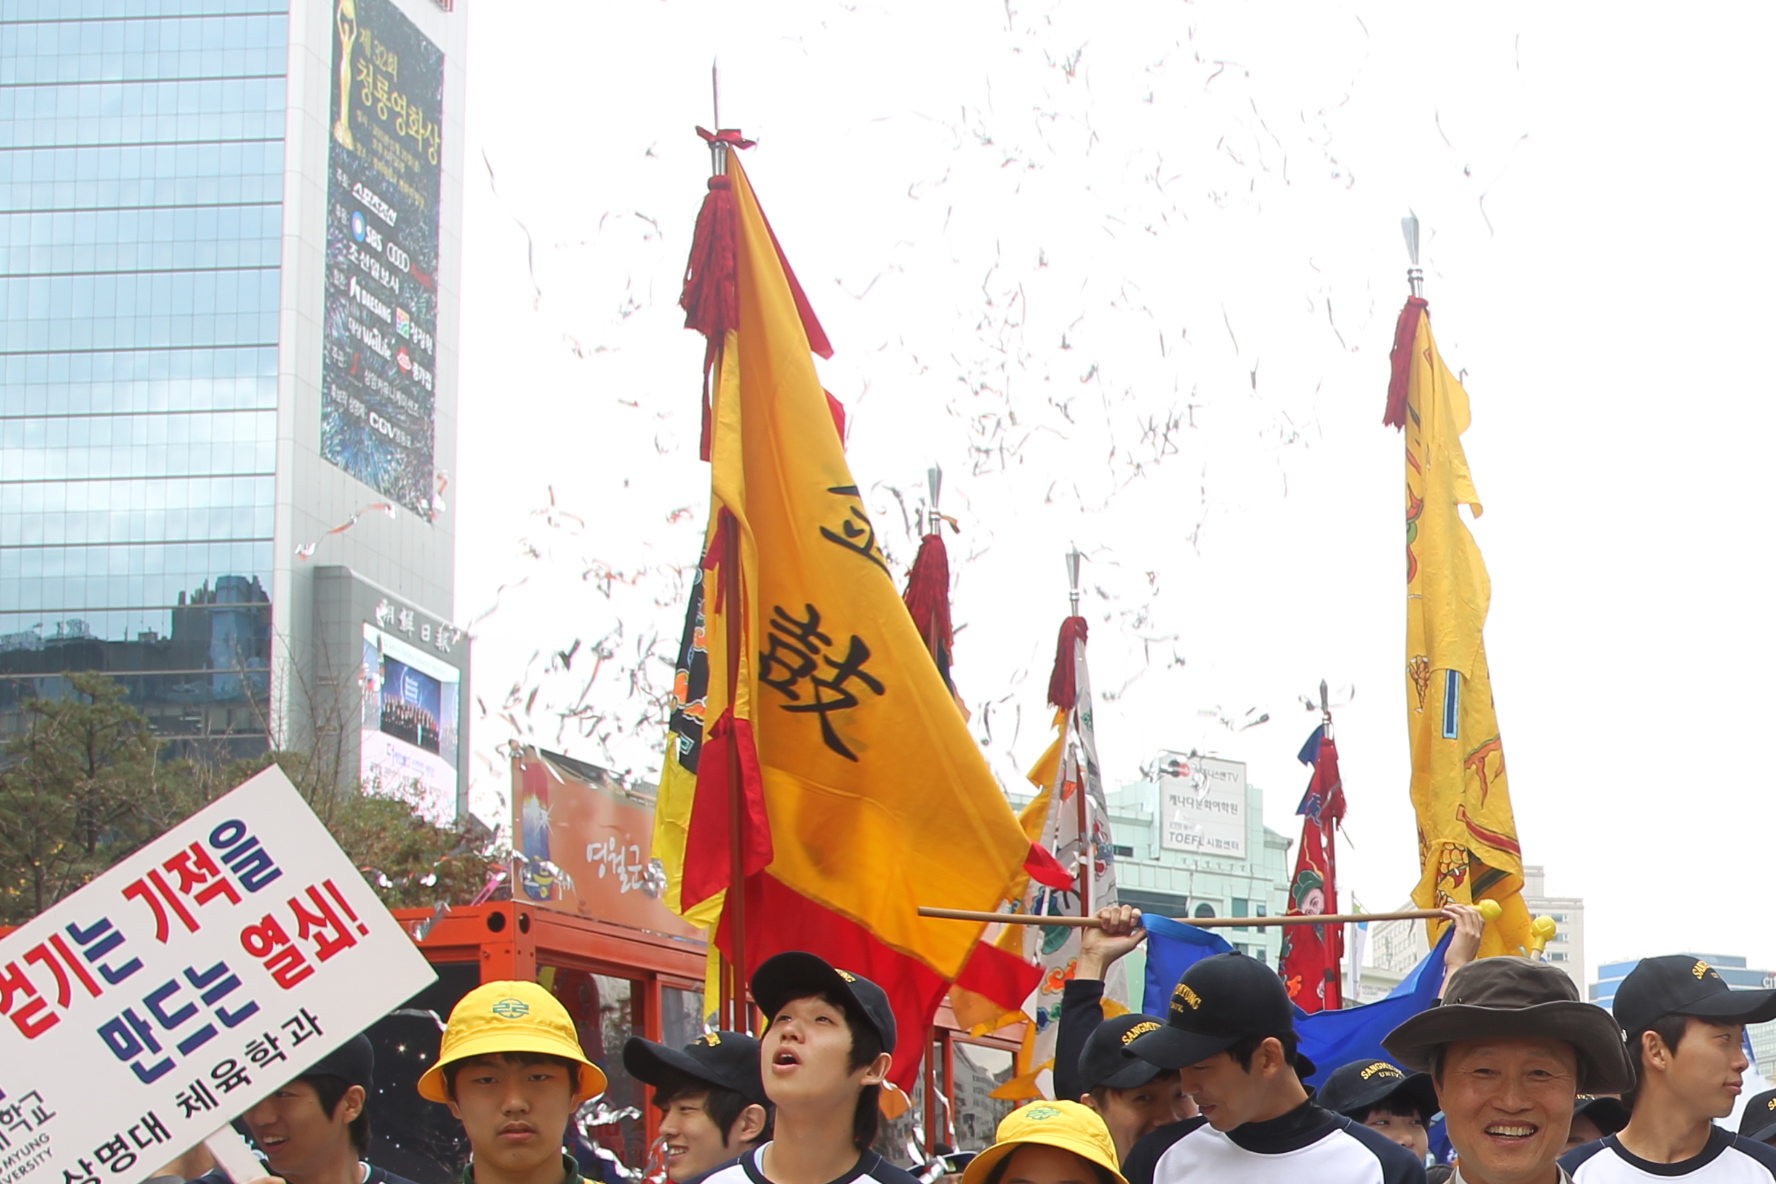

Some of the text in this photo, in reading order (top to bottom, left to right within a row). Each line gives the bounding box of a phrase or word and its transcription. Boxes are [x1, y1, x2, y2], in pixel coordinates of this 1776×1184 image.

[357, 58, 441, 165] 청룡영화상
[366, 226, 383, 251] SBS
[348, 241, 399, 294] 조선일보사
[369, 411, 395, 438] CGV
[1169, 831, 1205, 847] TOEFL
[0, 818, 284, 1040] 걷기는 기적을
[96, 878, 371, 1085] 만드는 열쇠!
[174, 1007, 325, 1122] 체육학과
[0, 1132, 51, 1176] MYUNG
